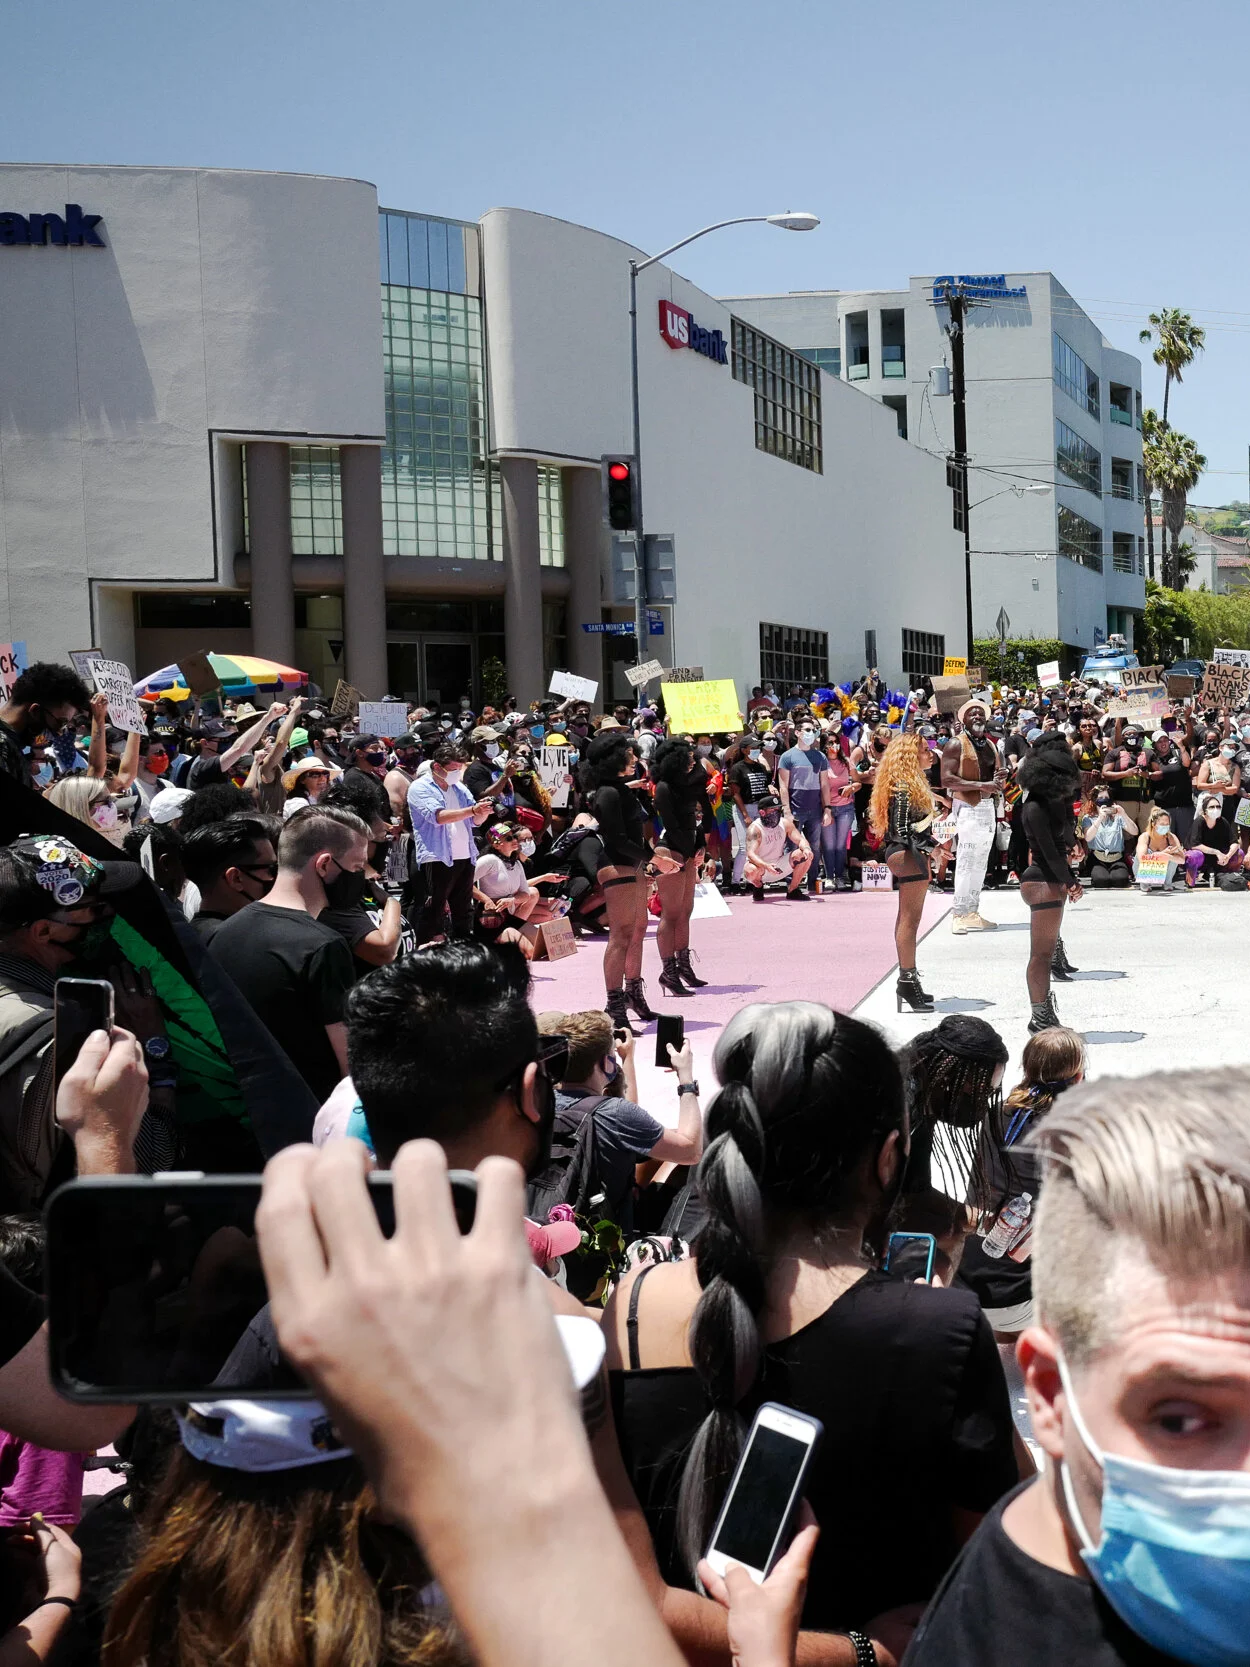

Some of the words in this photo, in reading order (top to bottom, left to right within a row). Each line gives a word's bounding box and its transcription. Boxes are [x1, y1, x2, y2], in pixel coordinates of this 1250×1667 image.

[689, 313, 728, 365] bank
[606, 623, 625, 631] MONICA
[945, 660, 966, 668] DEFEND
[1122, 669, 1168, 687] BLACK
[1208, 664, 1250, 682] BLACK
[1211, 678, 1249, 691] TRANS
[1207, 683, 1243, 699] LIVES
[364, 703, 407, 714] DEFUND
[363, 722, 407, 734] POLICE
[863, 866, 889, 874] JUSTICE
[40, 873, 69, 884] 2020
[867, 873, 887, 881] NOW
